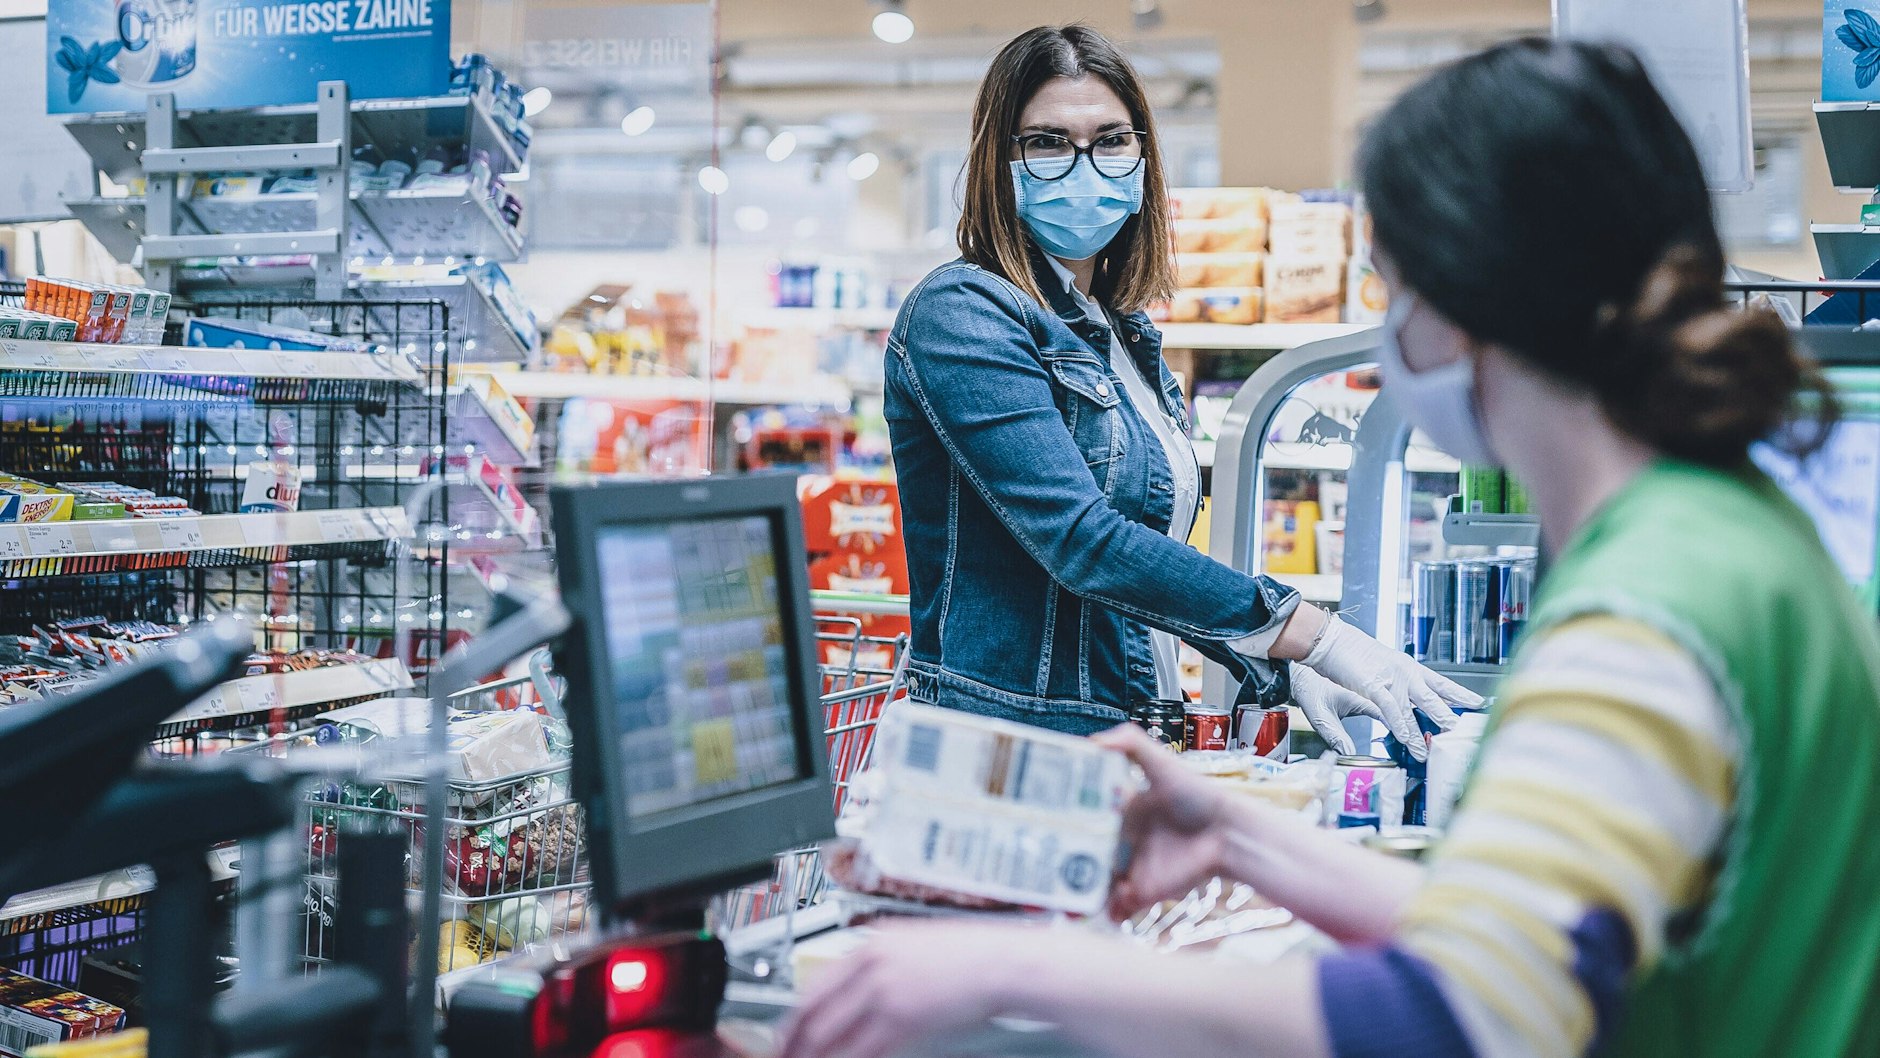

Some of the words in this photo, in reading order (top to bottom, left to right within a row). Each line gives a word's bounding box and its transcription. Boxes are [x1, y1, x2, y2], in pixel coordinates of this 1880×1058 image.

[214, 2, 259, 37] FÜR
[262, 1, 351, 36] WEISSE
[21, 497, 54, 515] DEXTRO
